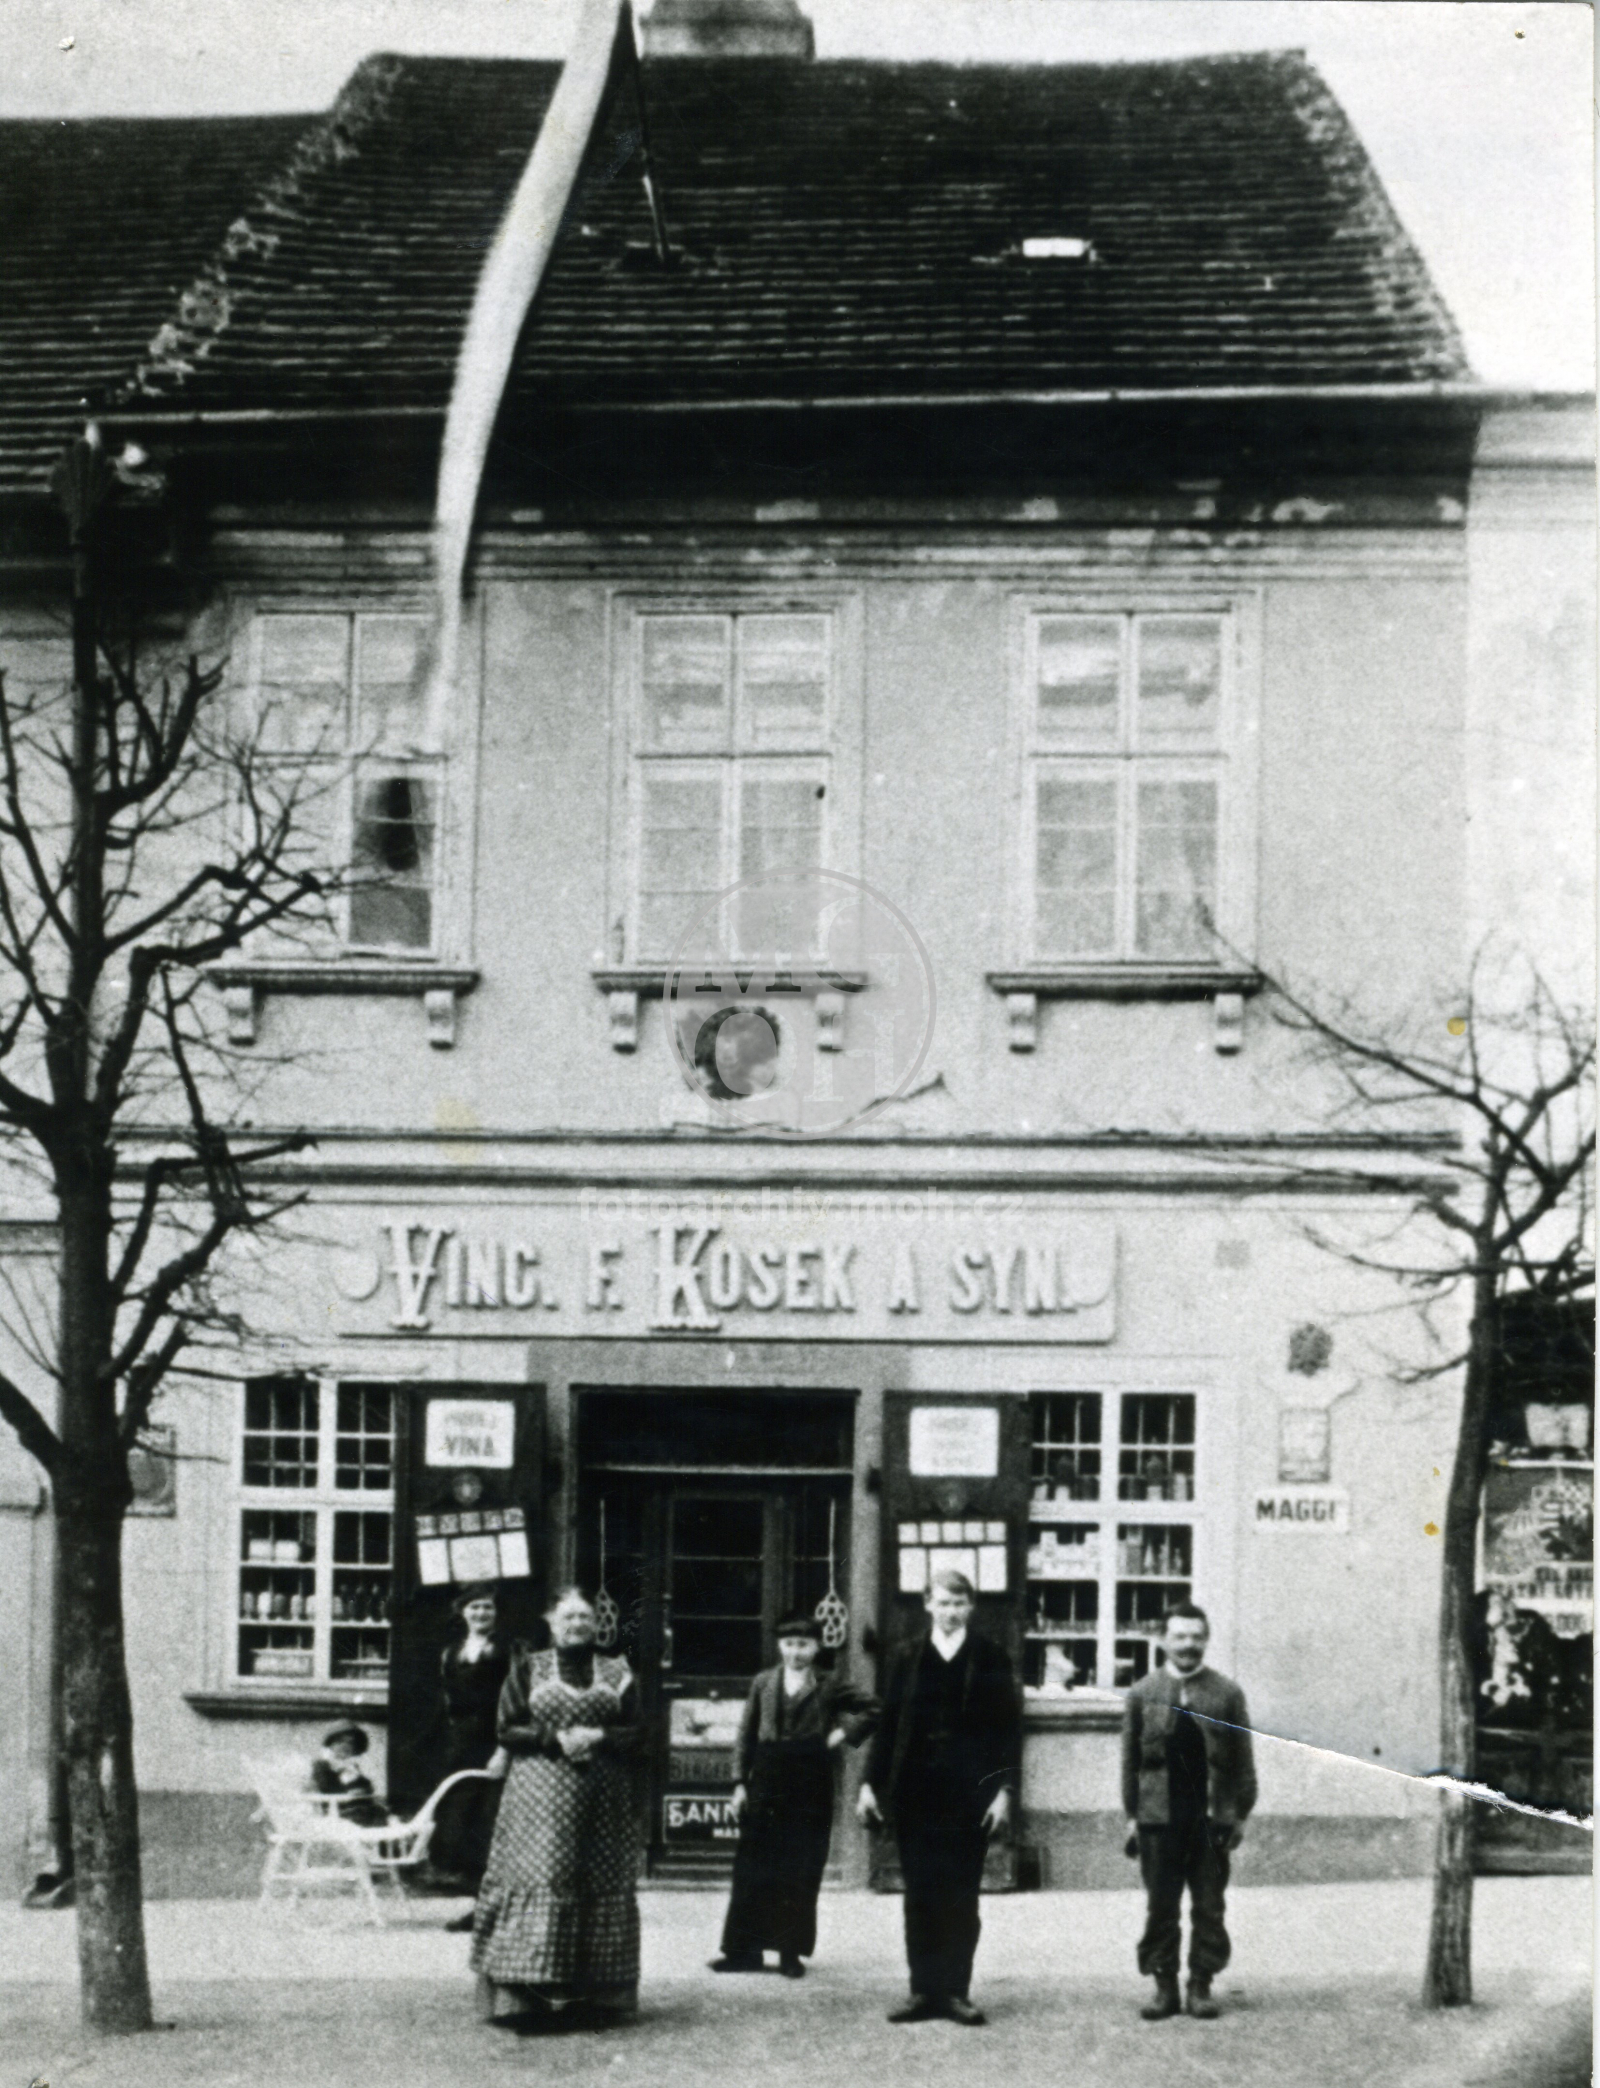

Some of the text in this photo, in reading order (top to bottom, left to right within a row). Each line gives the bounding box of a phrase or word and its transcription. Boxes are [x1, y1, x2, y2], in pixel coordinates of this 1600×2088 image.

[586, 1239, 624, 1311] F.
[649, 1222, 857, 1333] KOSEK
[887, 1240, 922, 1315] A
[1256, 1498, 1336, 1522] MAGGI
